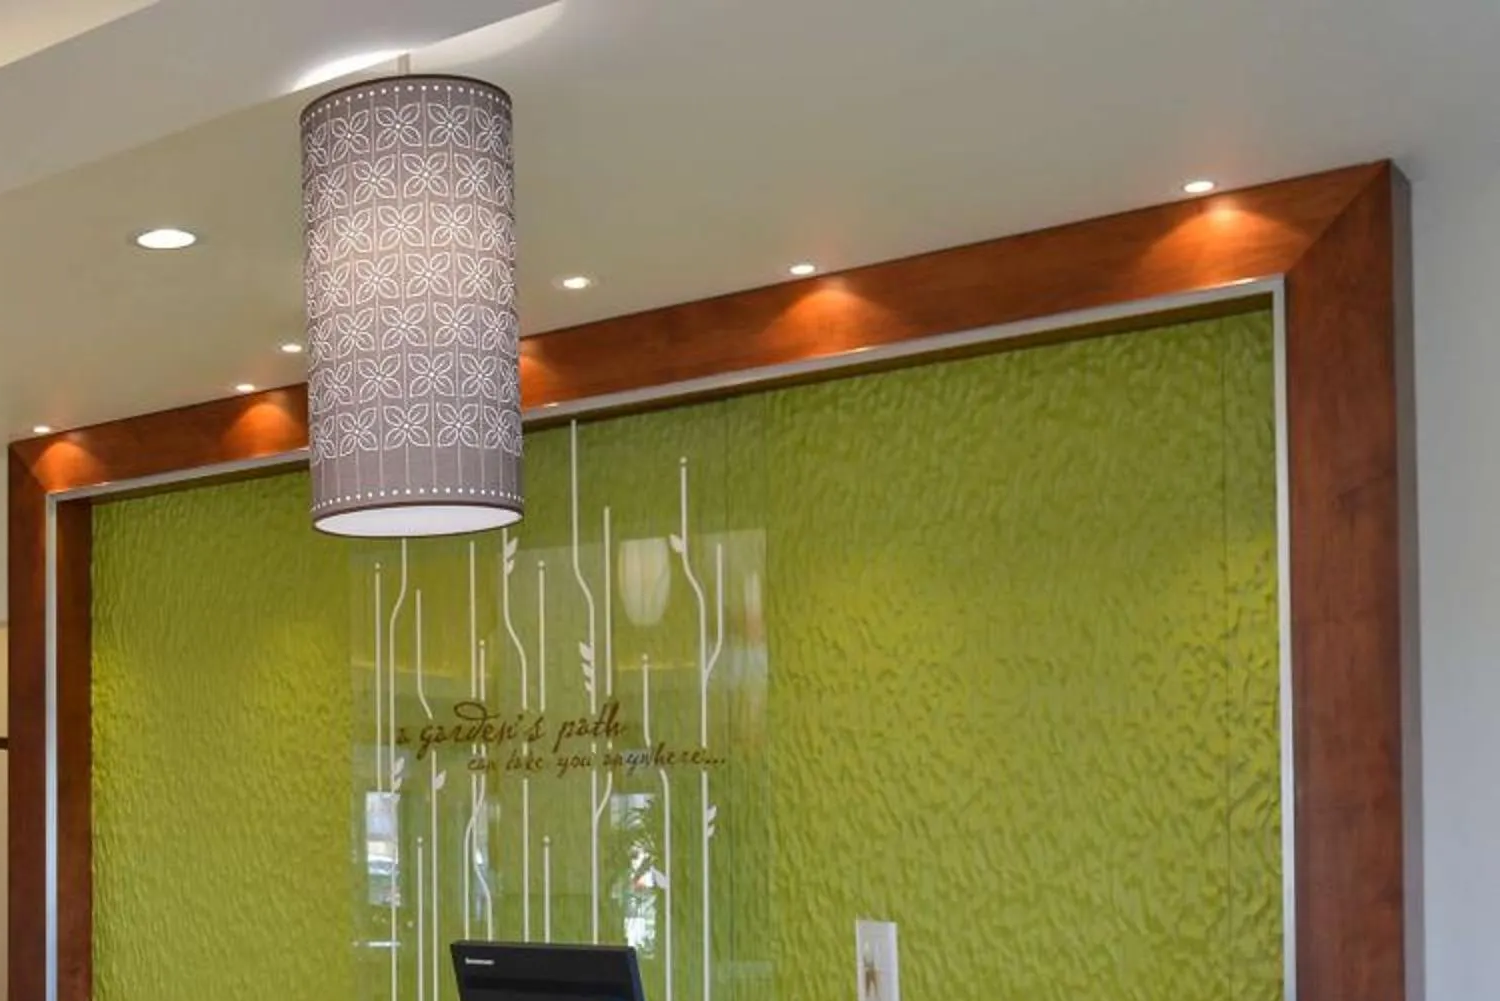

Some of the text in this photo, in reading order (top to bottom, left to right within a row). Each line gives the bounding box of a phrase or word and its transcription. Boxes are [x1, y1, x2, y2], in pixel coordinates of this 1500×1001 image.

[417, 701, 545, 760] garden's
[553, 702, 624, 753] path
[505, 749, 544, 772] take
[556, 755, 592, 778] you
